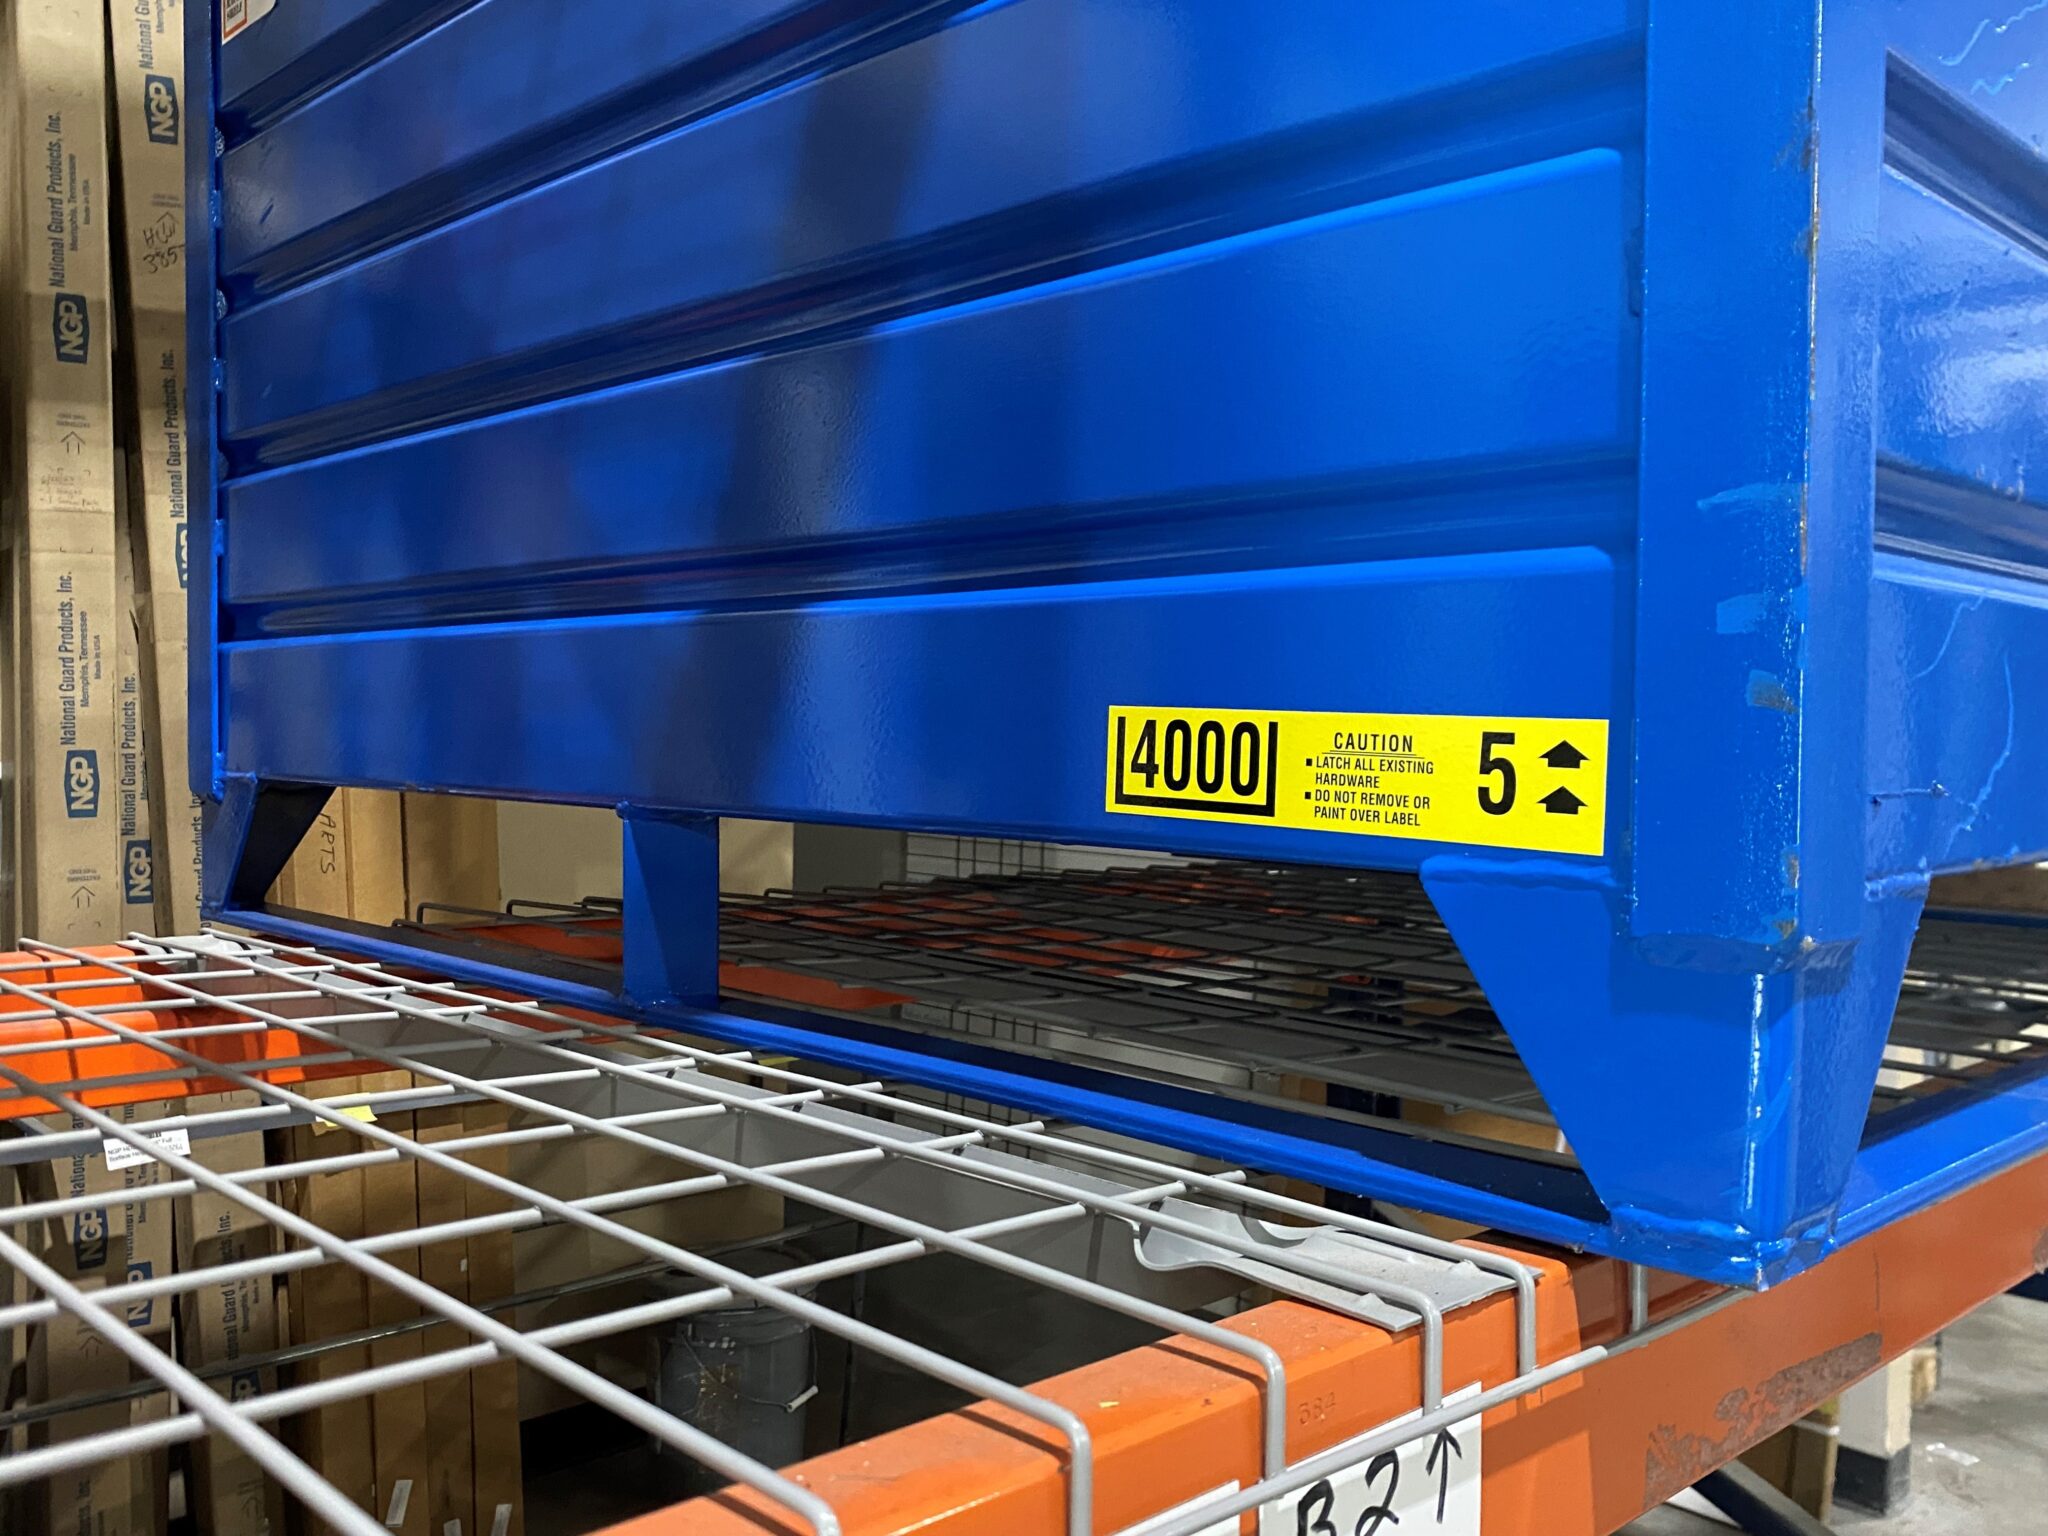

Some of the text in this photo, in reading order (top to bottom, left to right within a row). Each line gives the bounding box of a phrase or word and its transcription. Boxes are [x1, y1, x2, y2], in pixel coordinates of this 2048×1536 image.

[135, 18, 153, 69] National
[146, 80, 178, 139] NGP
[45, 112, 65, 287] National Guard Products, Inc.
[57, 299, 86, 358] NGP
[159, 350, 185, 519] National Guard Products, Inc.
[56, 571, 76, 746] National Guard Products, Inc.
[79, 610, 89, 661] Tennessee
[93, 634, 101, 651] USA
[120, 672, 138, 837] National Guard Products, Inc.
[1130, 718, 1261, 797] 4000
[1316, 755, 1434, 775] LATCH ALL EXISTING
[1333, 731, 1413, 753] CAUTION
[69, 756, 95, 810] NGP
[1315, 772, 1380, 789] HARDWARE
[1315, 788, 1431, 810] DO NOT REMOVE OR
[1477, 731, 1517, 816] 5
[1314, 805, 1421, 827] PAINT OVER LABEL
[127, 845, 152, 898] NGP
[78, 1209, 103, 1266] NGP
[216, 1210, 231, 1234] Inc.
[222, 1290, 237, 1323] Guard
